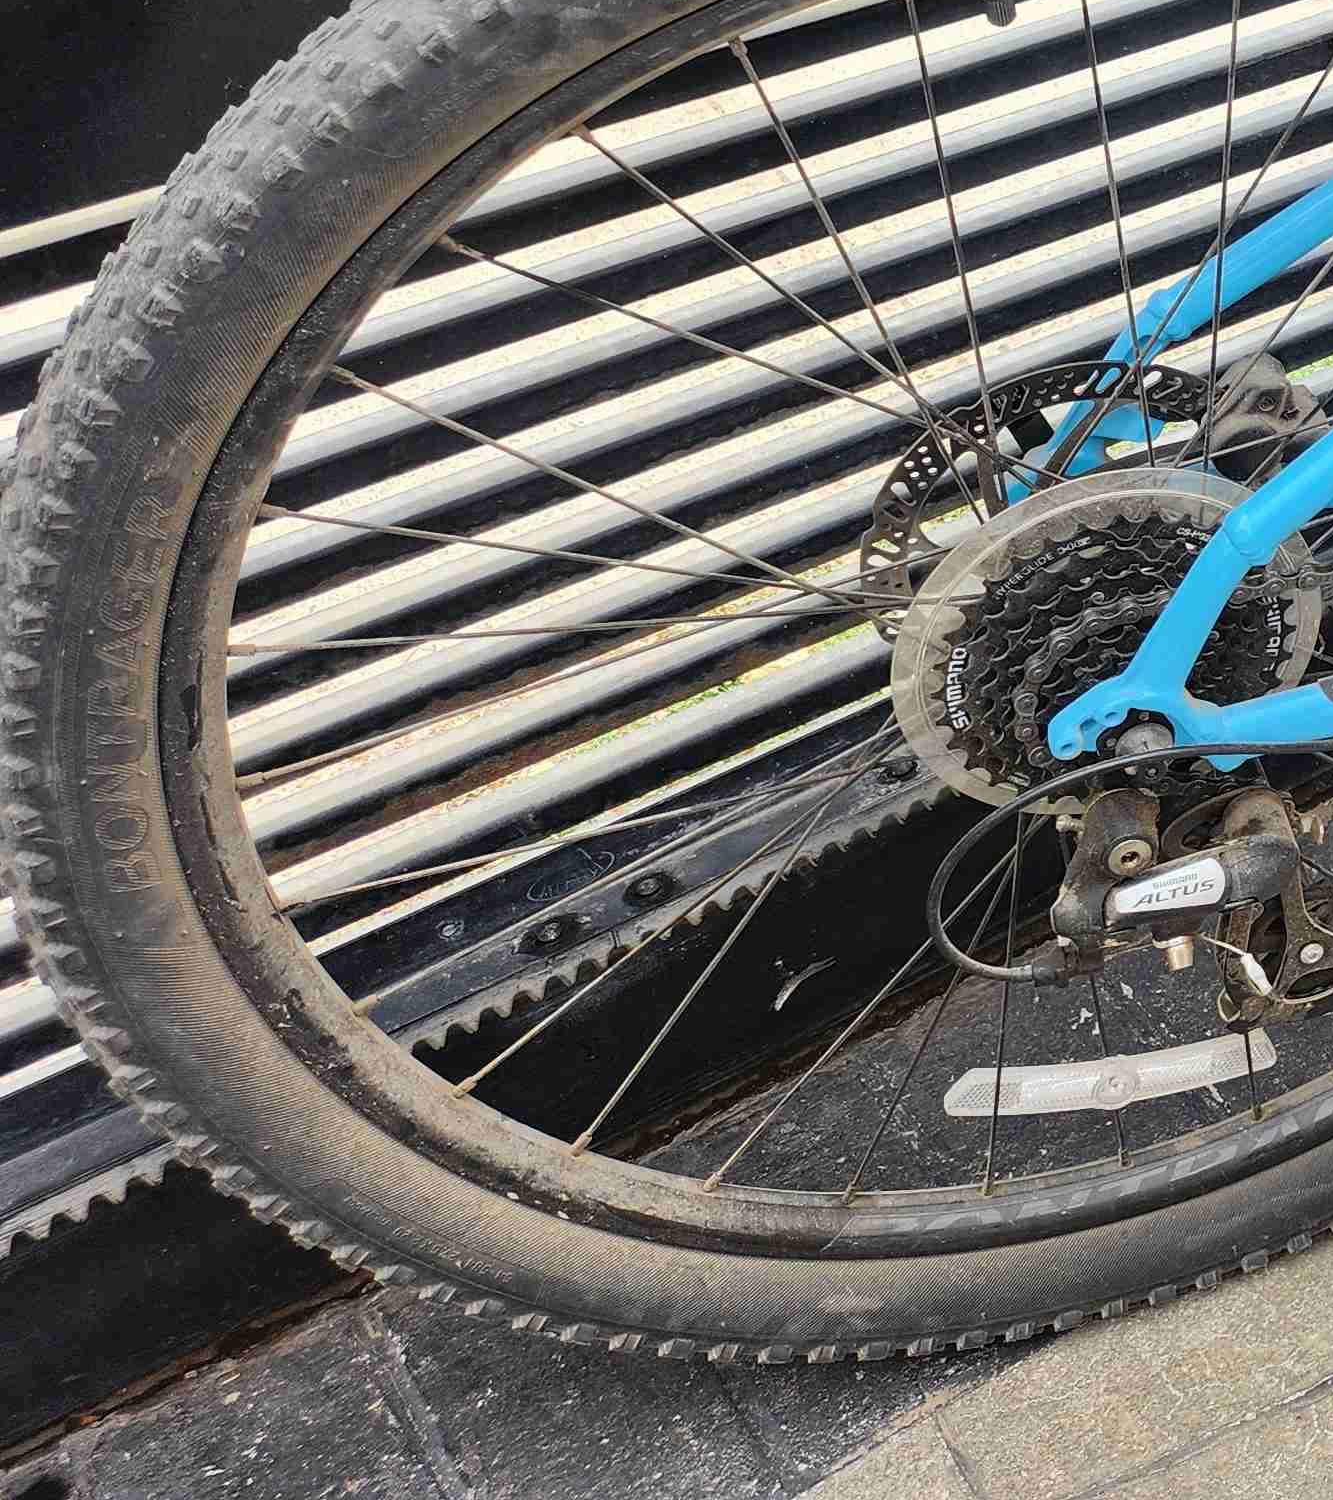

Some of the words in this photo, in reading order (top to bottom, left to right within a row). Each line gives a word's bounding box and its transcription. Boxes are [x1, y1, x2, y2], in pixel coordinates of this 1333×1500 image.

[86, 493, 171, 894] BONTRAGER
[945, 647, 972, 730] SHIMANO
[1132, 877, 1217, 909] ALTUS
